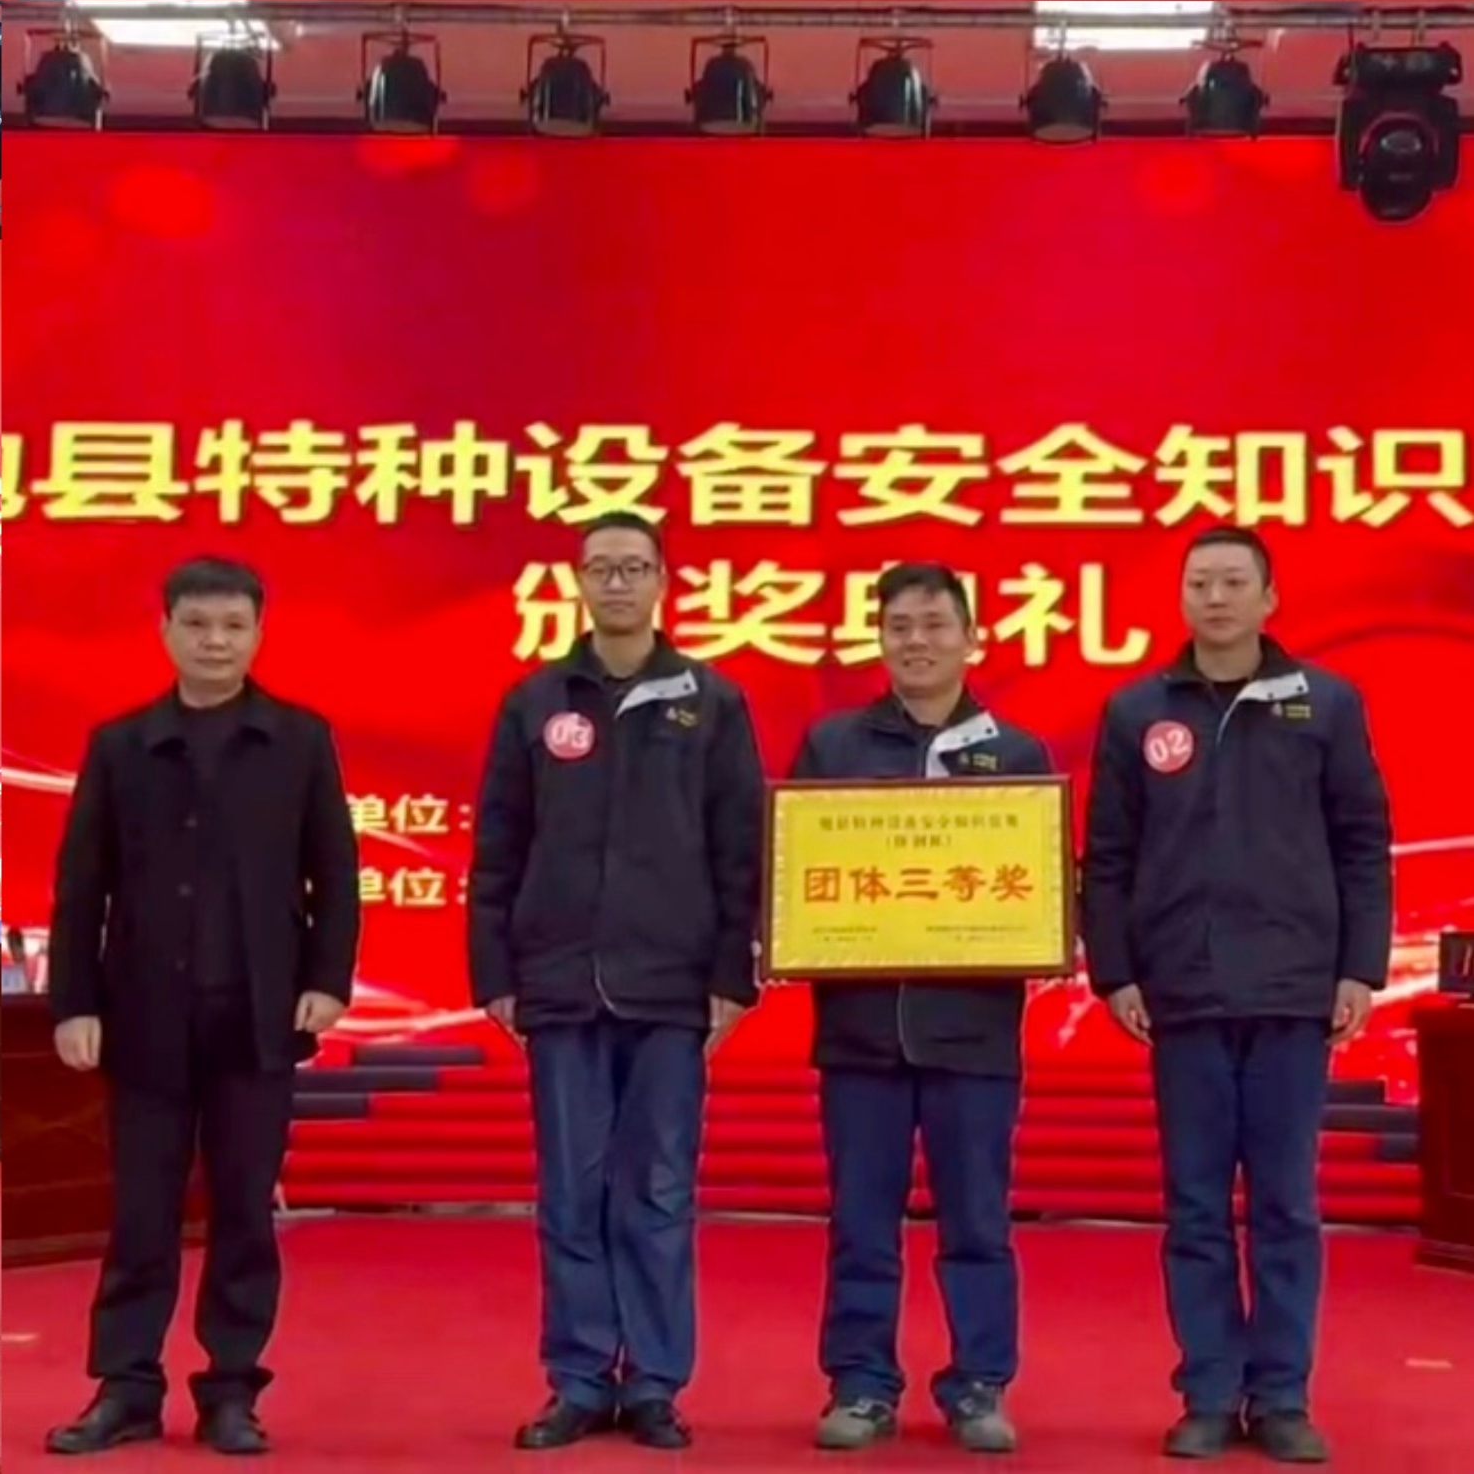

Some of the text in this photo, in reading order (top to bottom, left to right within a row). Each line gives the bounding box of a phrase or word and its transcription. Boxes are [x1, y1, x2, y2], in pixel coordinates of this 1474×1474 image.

[1150, 728, 1187, 763] 02
[804, 863, 1034, 904] 团体三等奖
